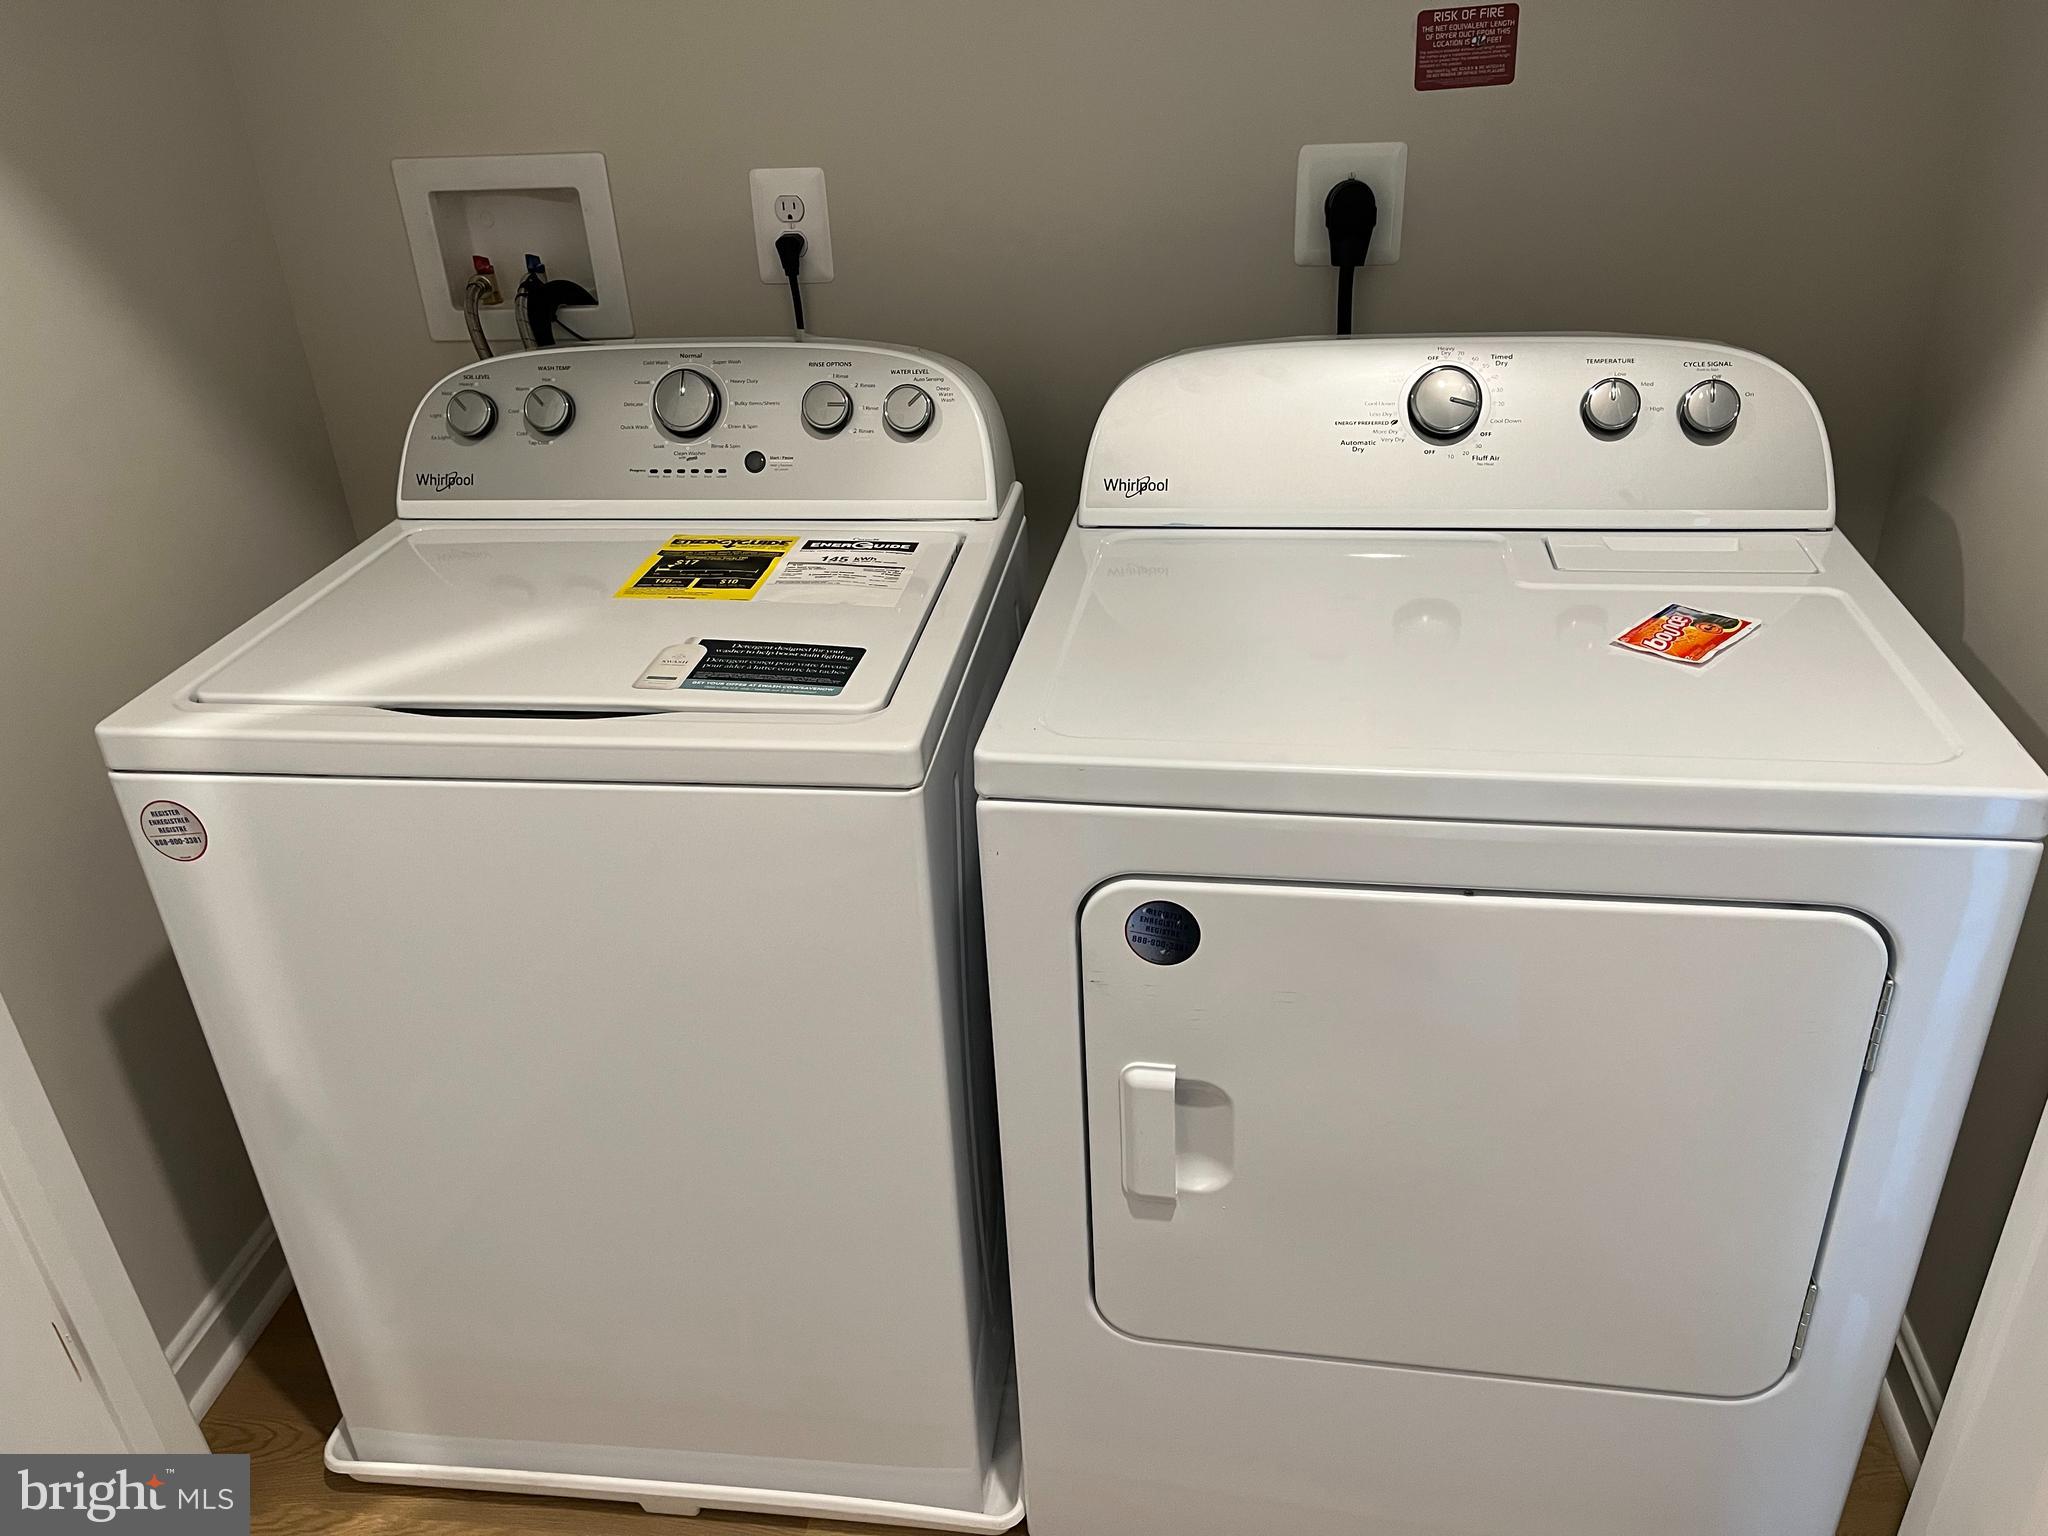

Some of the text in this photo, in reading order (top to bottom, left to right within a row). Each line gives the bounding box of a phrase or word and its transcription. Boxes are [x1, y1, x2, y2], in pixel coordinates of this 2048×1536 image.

[1434, 7, 1504, 22] RISK OF FIRE
[1422, 25, 1434, 33] THE
[1449, 21, 1487, 31] EQUIVALENT
[1436, 32, 1457, 40] DRYER
[1458, 30, 1475, 38] DUCT
[1433, 39, 1462, 48] LOCATION
[416, 472, 474, 491] Whirlpool
[1104, 477, 1168, 497] Whirlpool
[810, 541, 911, 550] ENERGUIDE
[1643, 614, 1692, 652] bounce
[732, 643, 774, 651] Detergent
[775, 645, 811, 653] designed
[820, 653, 855, 661] fighting
[150, 809, 181, 818] REGISTER
[148, 817, 190, 826] ENREGISTRER
[158, 826, 187, 834] REGISTRE
[1145, 926, 1180, 938] REGISTRE
[1131, 935, 1188, 951] 888-900-3
